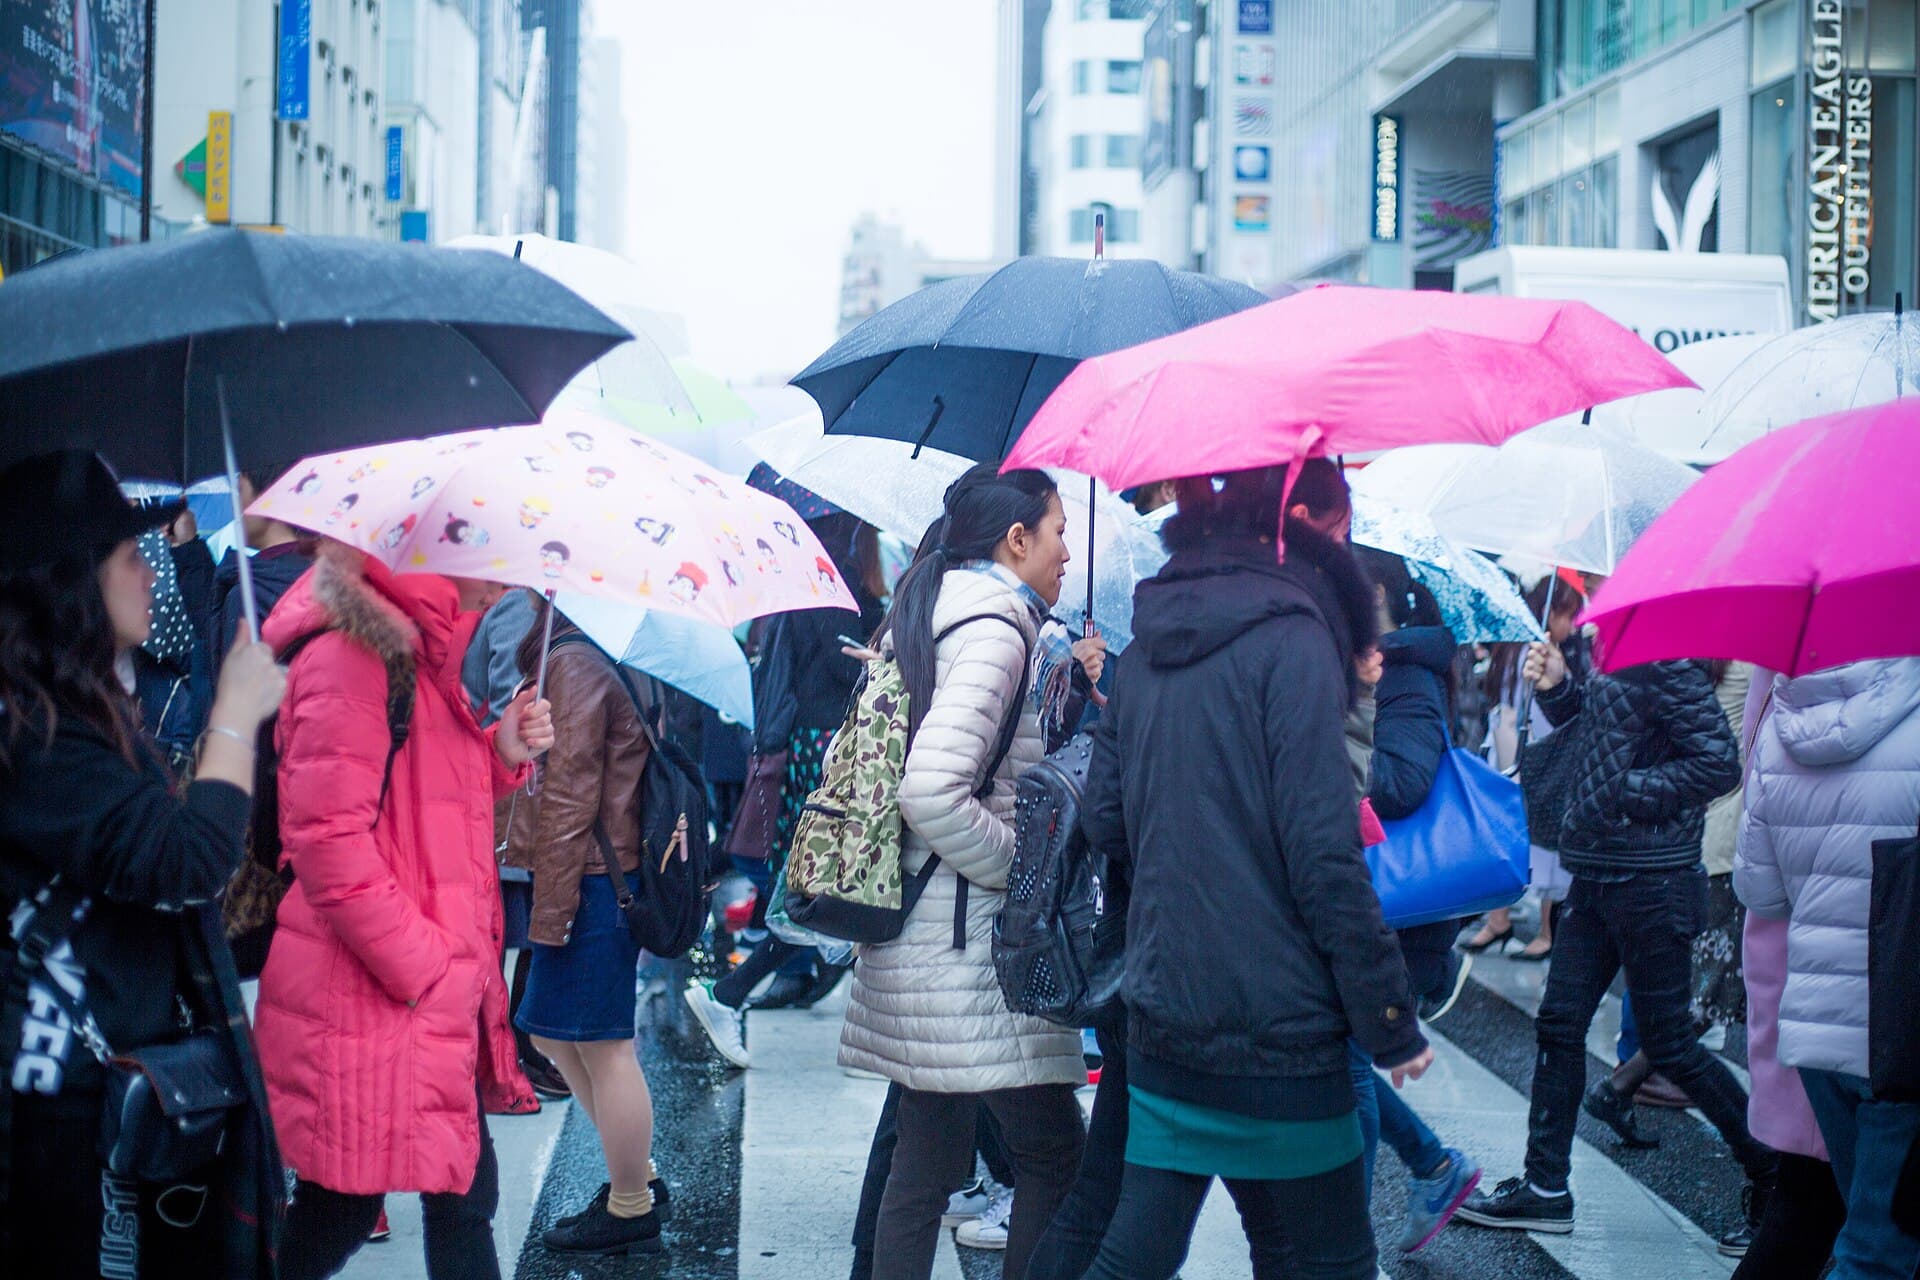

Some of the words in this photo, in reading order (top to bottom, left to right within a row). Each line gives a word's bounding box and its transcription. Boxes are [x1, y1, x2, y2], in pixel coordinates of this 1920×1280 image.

[1811, 0, 1842, 132] EAGLE
[1807, 145, 1841, 323] MERICAN
[1843, 77, 1872, 294] OUTFITTERS
